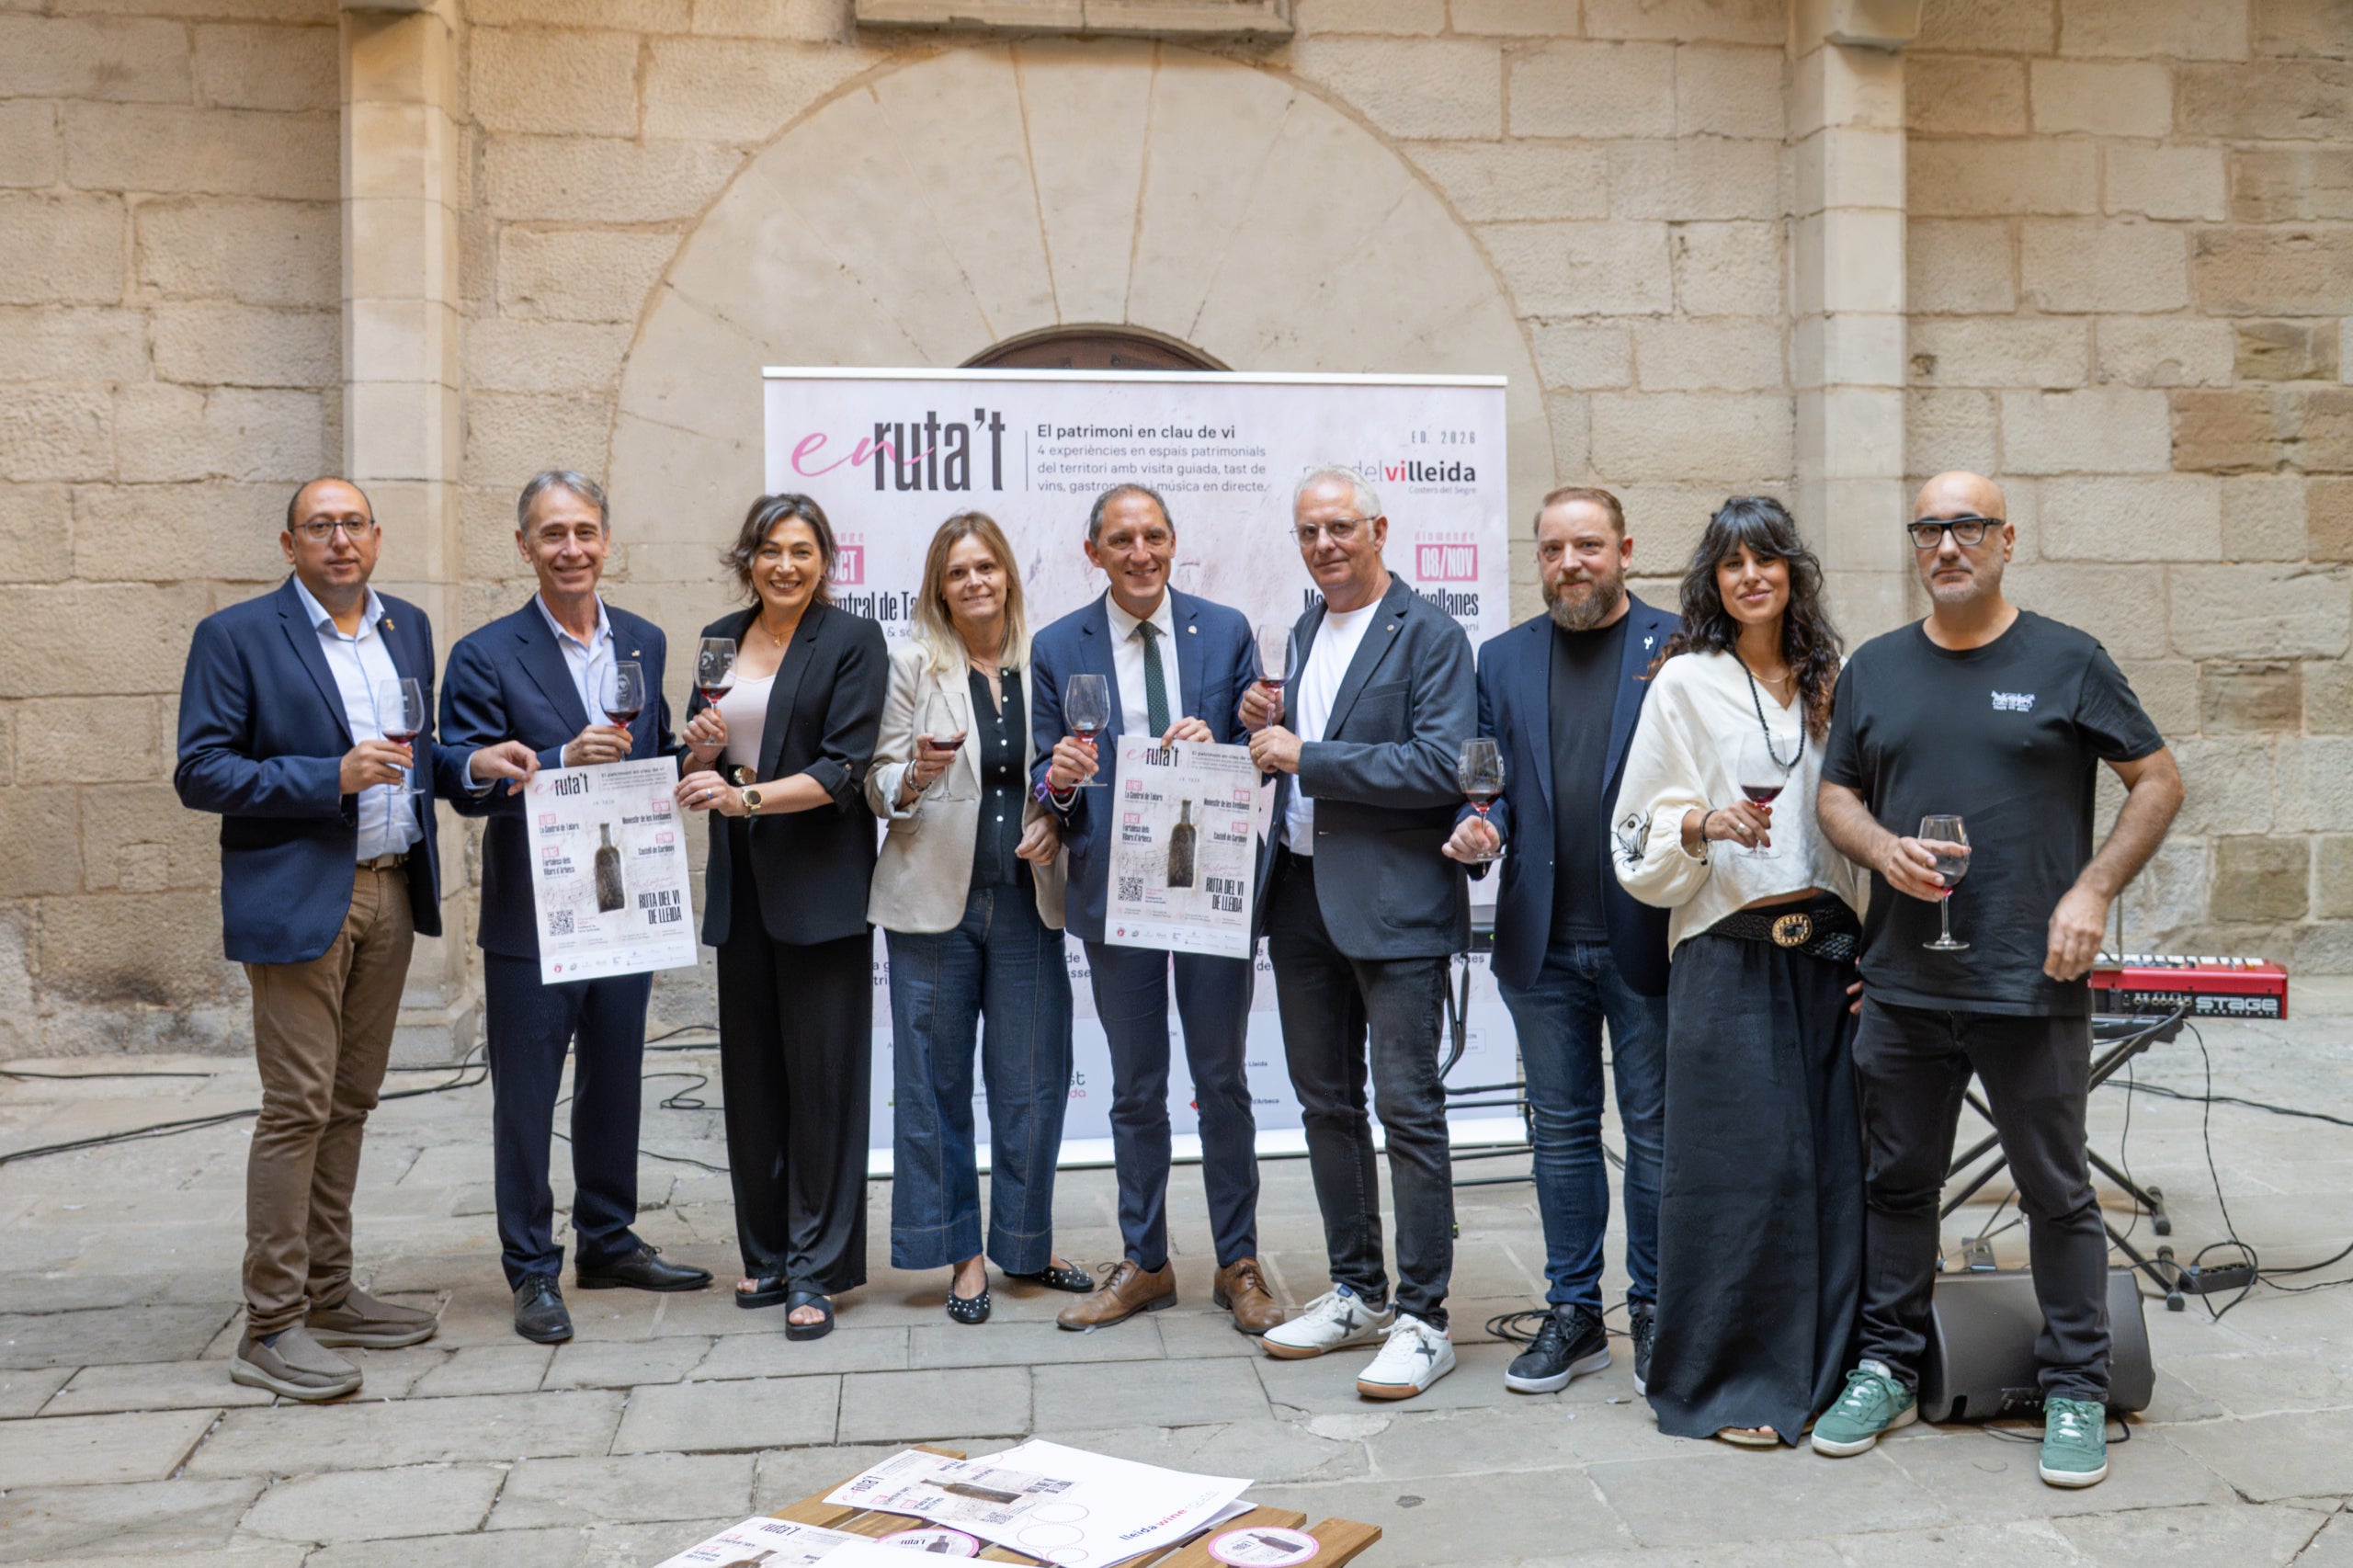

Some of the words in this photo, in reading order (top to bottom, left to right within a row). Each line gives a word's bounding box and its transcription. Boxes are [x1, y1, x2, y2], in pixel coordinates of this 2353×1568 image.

[1037, 425, 1051, 437] El
[1057, 424, 1132, 440] patrimoni
[1138, 426, 1155, 438] en
[1161, 424, 1193, 438] clau
[1198, 425, 1217, 438] de
[1221, 425, 1235, 438] vi
[1441, 430, 1476, 444] 2026
[791, 433, 936, 477] en
[874, 408, 1006, 491] ruta't
[1037, 445, 1045, 456] 4
[1049, 444, 1127, 459] experiències
[1131, 447, 1145, 457] en
[1149, 446, 1188, 459] espais
[1191, 444, 1266, 460] patrimonials
[1037, 462, 1056, 474] del
[1060, 462, 1107, 475] territori
[1111, 463, 1137, 475] amb
[1141, 463, 1173, 475] visita
[1176, 463, 1221, 478] guiada,
[1224, 464, 1247, 475] tast
[1250, 464, 1267, 475] de
[1038, 480, 1066, 493] vins,
[1157, 479, 1199, 492] música
[1202, 483, 1219, 493] en
[1222, 481, 1267, 493] directe.
[1421, 545, 1474, 580] 08/NOV
[880, 591, 897, 620] de
[1146, 745, 1179, 767] ruta't
[554, 773, 588, 797] ruta't
[1206, 877, 1222, 893] RUTA
[1224, 879, 1235, 895] DEL
[1237, 881, 1245, 896] VI
[638, 892, 657, 909] RUTA
[658, 891, 671, 907] DEL
[672, 889, 680, 905] VI
[1212, 893, 1221, 910] DE
[1222, 895, 1243, 913] LLEIDA
[648, 908, 657, 925] DE
[658, 906, 682, 924] LLEIDA
